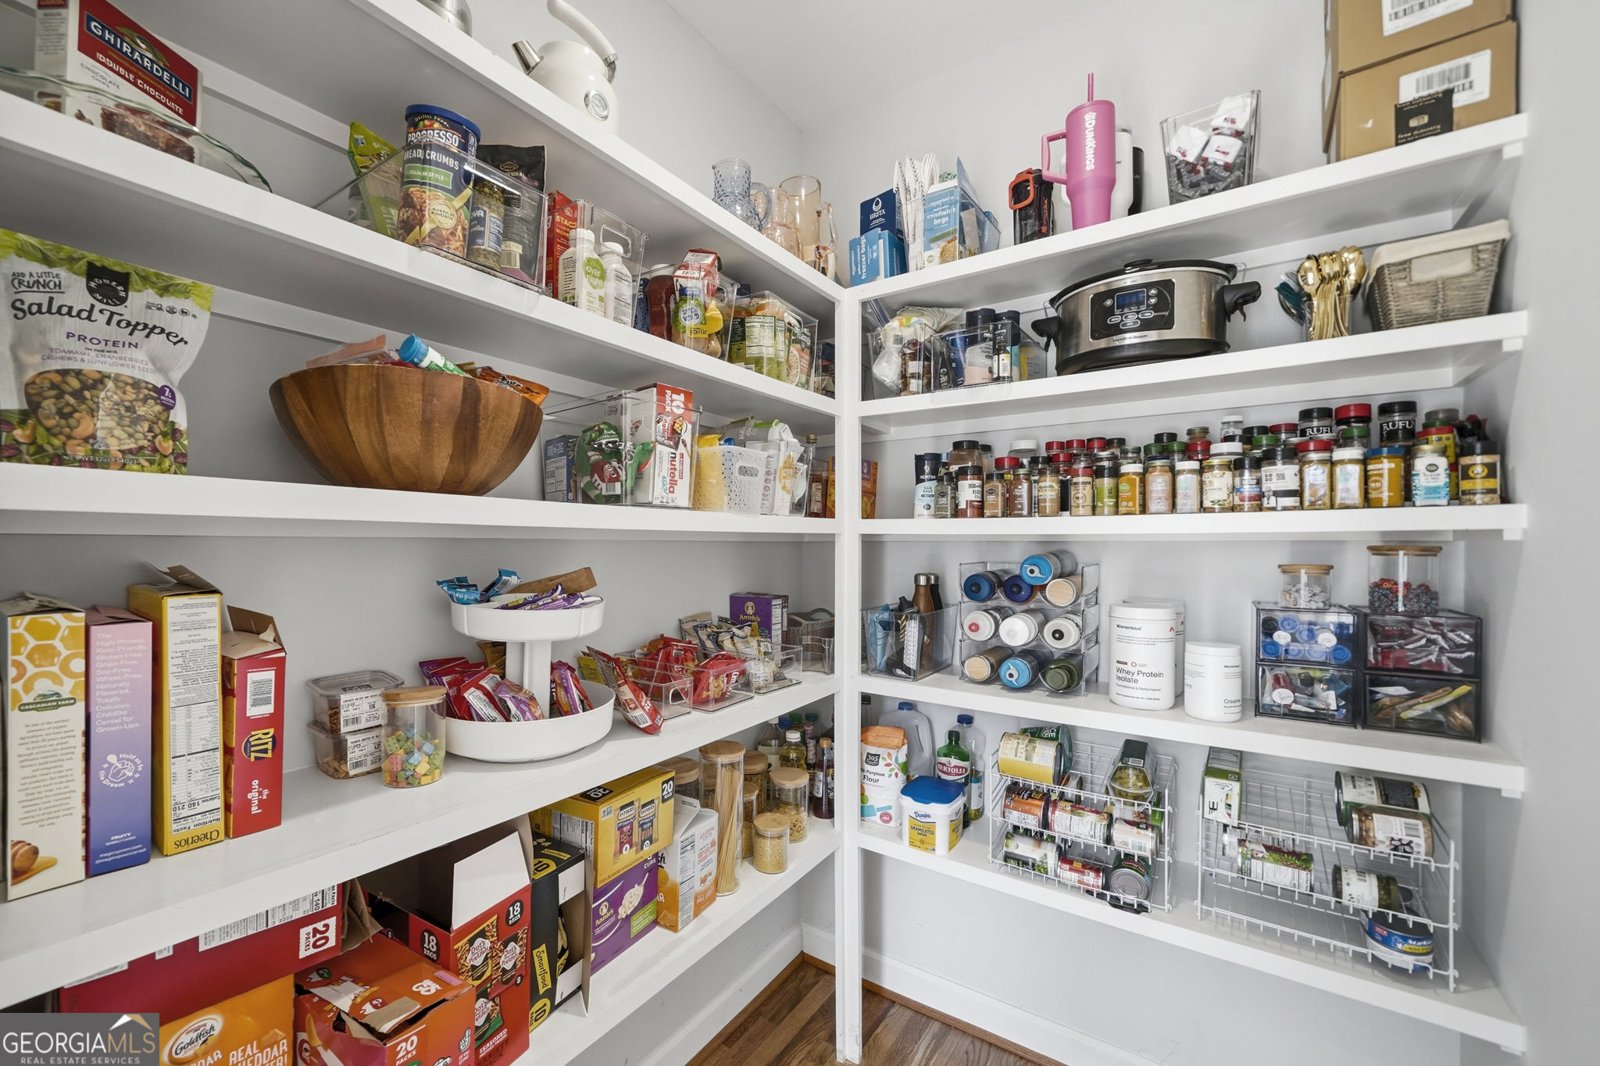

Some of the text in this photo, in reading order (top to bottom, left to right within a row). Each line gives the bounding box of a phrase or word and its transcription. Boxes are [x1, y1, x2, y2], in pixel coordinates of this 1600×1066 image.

[90, 20, 190, 98] GHIRARDELLI
[95, 52, 135, 82] DOUBLE
[137, 77, 184, 116] CHOCOLATE
[425, 150, 460, 170] CRUMBS
[11, 278, 62, 291] CRUNCH
[11, 296, 97, 323] Salad
[99, 308, 189, 347] Topper
[65, 331, 139, 349] PROTEIN
[671, 393, 685, 415] 10
[668, 451, 678, 494] nutella
[1115, 667, 1164, 678] Whey Protein
[1115, 674, 1139, 684] Isolate
[249, 728, 275, 762] RITZ
[662, 780, 674, 796] 20
[862, 775, 880, 784] Flour
[247, 779, 263, 814] original
[174, 829, 220, 849] Cheerios
[509, 902, 521, 919] 18
[312, 923, 330, 949] 20
[423, 932, 437, 952] 18
[535, 949, 548, 990] Smartfood
[534, 1002, 547, 1023] 10
[174, 1024, 217, 1056] Goldfish
[396, 1035, 418, 1060] 20
[229, 1040, 260, 1066] REAL
